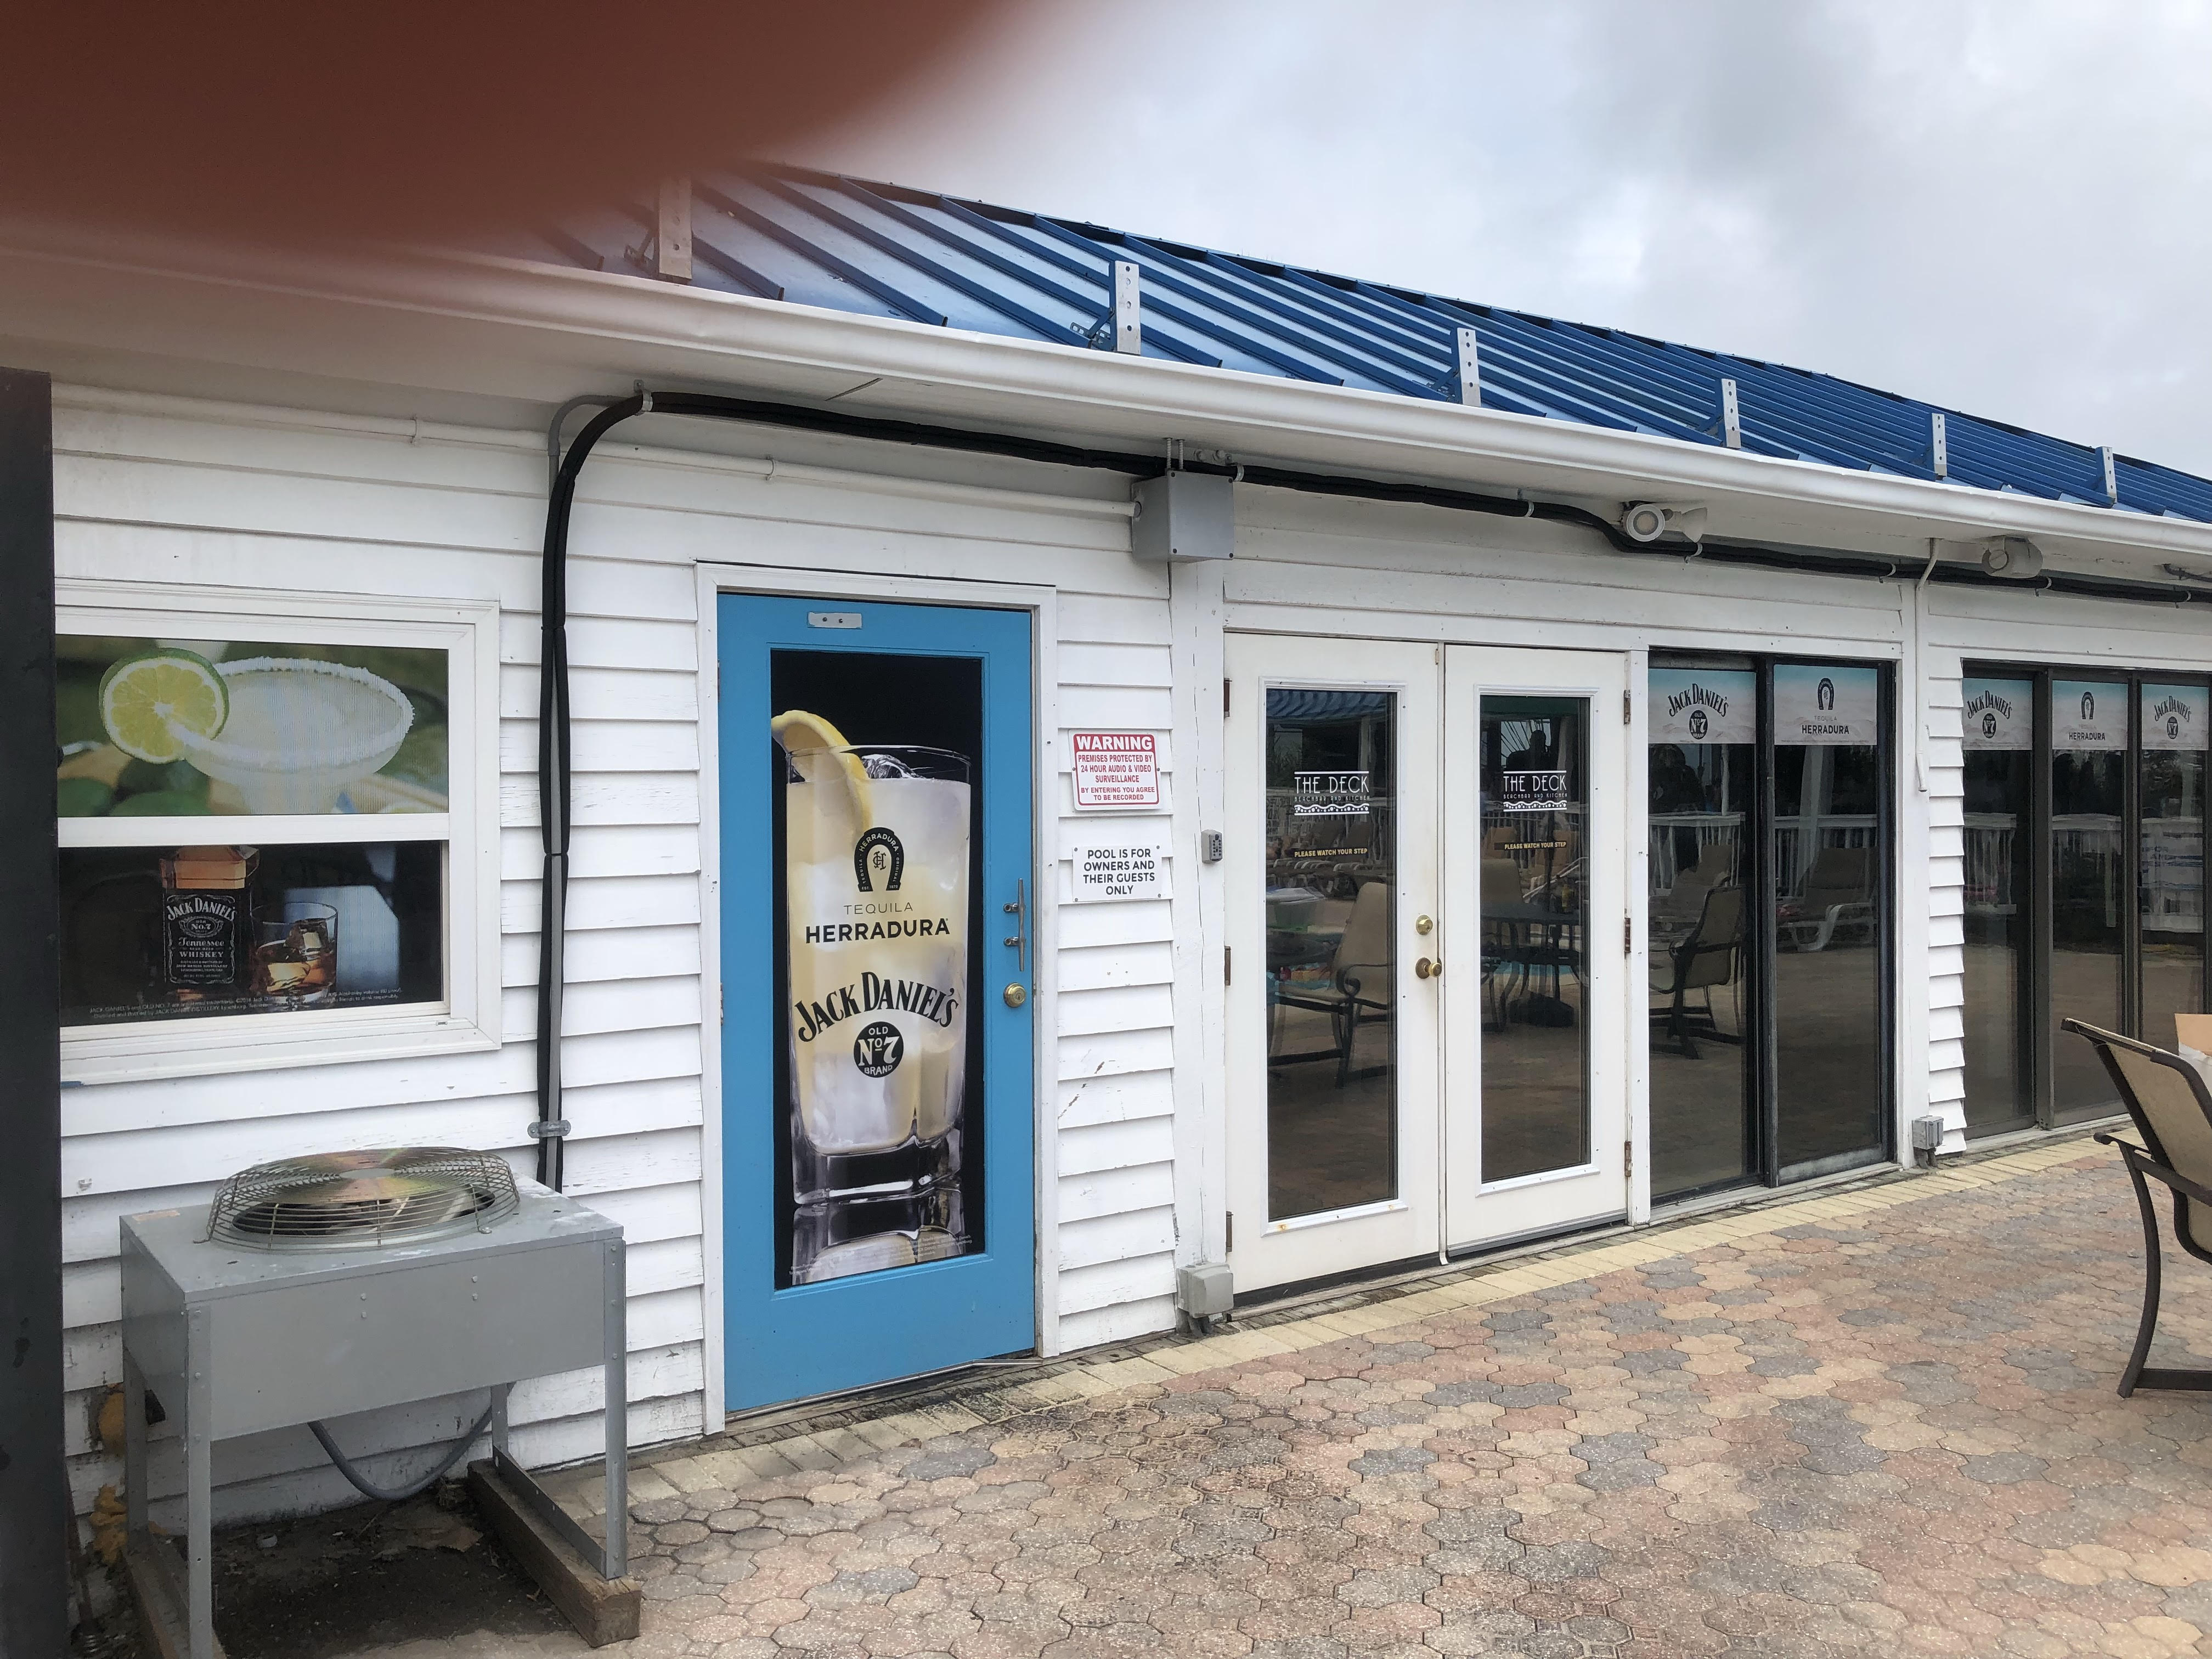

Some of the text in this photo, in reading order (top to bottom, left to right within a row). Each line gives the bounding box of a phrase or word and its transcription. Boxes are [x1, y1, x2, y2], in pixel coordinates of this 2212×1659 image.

[1668, 683, 1729, 717] JACK DANIEL'S
[1967, 690, 2012, 719] JACK DANIEL'S
[2154, 699, 2169, 721] JACK
[1802, 725, 1849, 734] HERRADURA
[1076, 736, 1152, 750] WARNING
[2069, 732, 2106, 741] HERRADURA
[1294, 776, 1369, 794] THE DECK
[1503, 775, 1567, 792] THE DECK
[859, 833, 899, 851] HERRADURA
[1087, 848, 1151, 859] POOL IS FOR
[1084, 860, 1155, 871] OWNERS AND
[1083, 872, 1155, 884] THEIR GUESTS
[1105, 885, 1133, 895] ONLY
[166, 897, 238, 921] JACK DANIEL'S
[843, 902, 913, 915] TEQUILA
[805, 918, 950, 944] HERRADURA
[178, 937, 224, 946] Tennessee
[794, 972, 959, 1042] JACK DANIEL'S
[868, 1026, 888, 1035] OLD
[864, 1065, 893, 1075] BRAND
